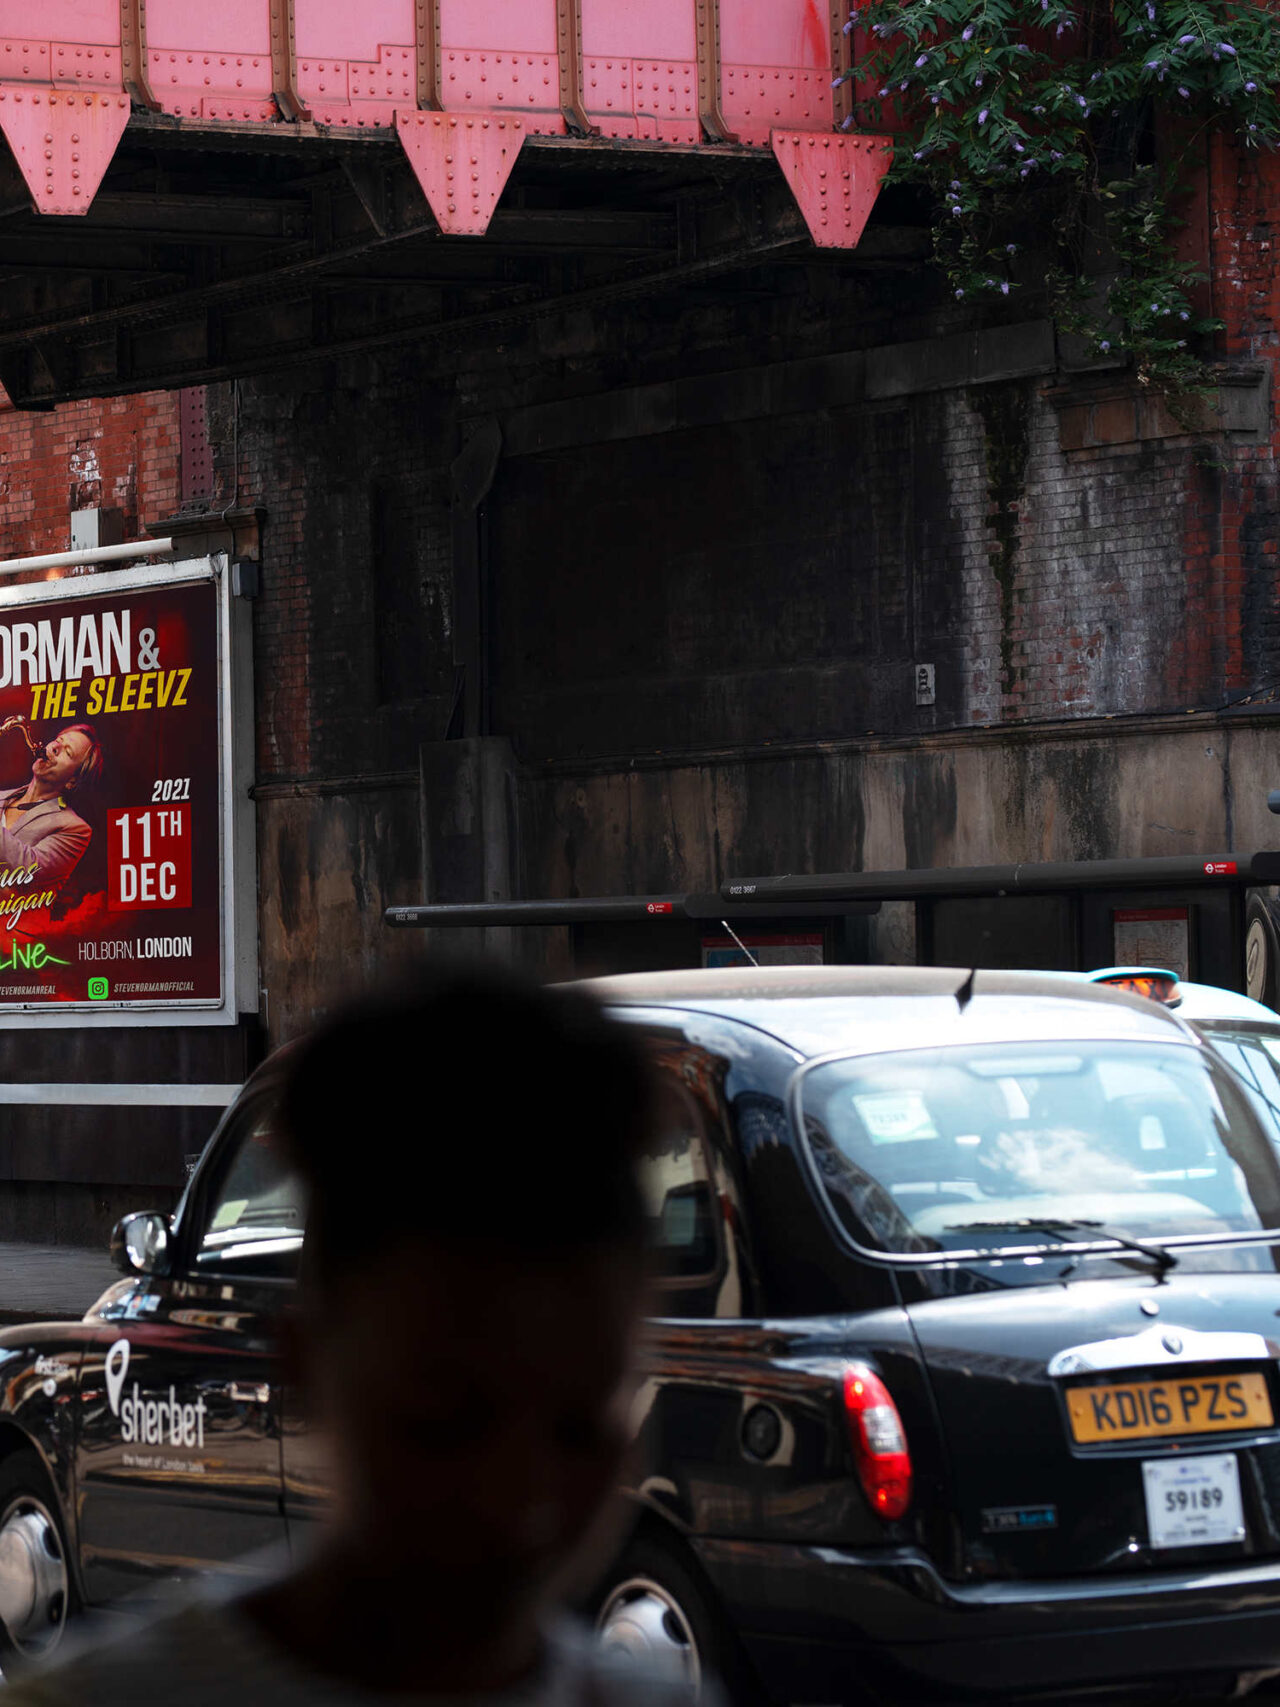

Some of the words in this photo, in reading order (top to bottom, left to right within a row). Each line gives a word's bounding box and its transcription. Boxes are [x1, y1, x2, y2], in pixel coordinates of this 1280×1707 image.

[137, 627, 161, 670] &
[30, 680, 81, 721] THE
[86, 668, 192, 716] SLEEVZ
[151, 777, 190, 802] 2021
[120, 861, 176, 903] DEC
[78, 941, 134, 961] HOLBORN,
[137, 936, 192, 959] LONDON
[113, 981, 195, 993] STEVENORMANOFFICIAL
[121, 1381, 207, 1448] sherbet
[1091, 1387, 1172, 1430] KD16
[1178, 1381, 1248, 1422] PZS
[1165, 1487, 1223, 1513] 59189
